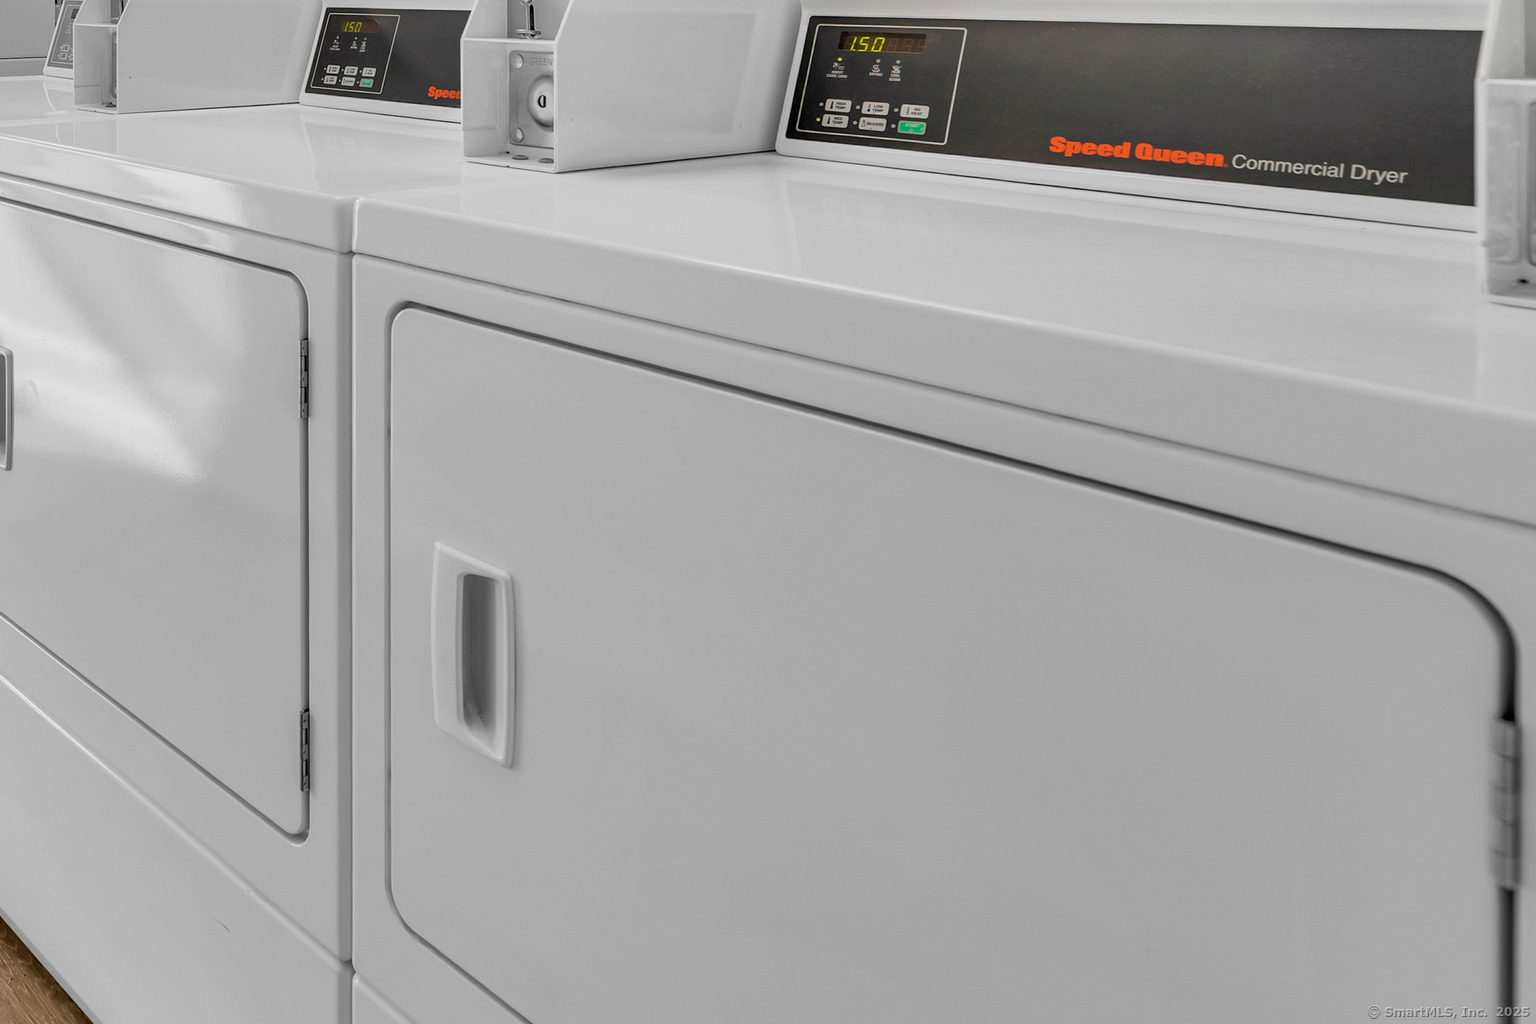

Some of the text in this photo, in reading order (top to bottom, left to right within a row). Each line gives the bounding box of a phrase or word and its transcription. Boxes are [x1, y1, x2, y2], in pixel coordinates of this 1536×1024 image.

[850, 36, 886, 52] 1.50
[529, 57, 554, 65] GREEN
[1049, 136, 1408, 186] Speed Queen Commercial Dryer
